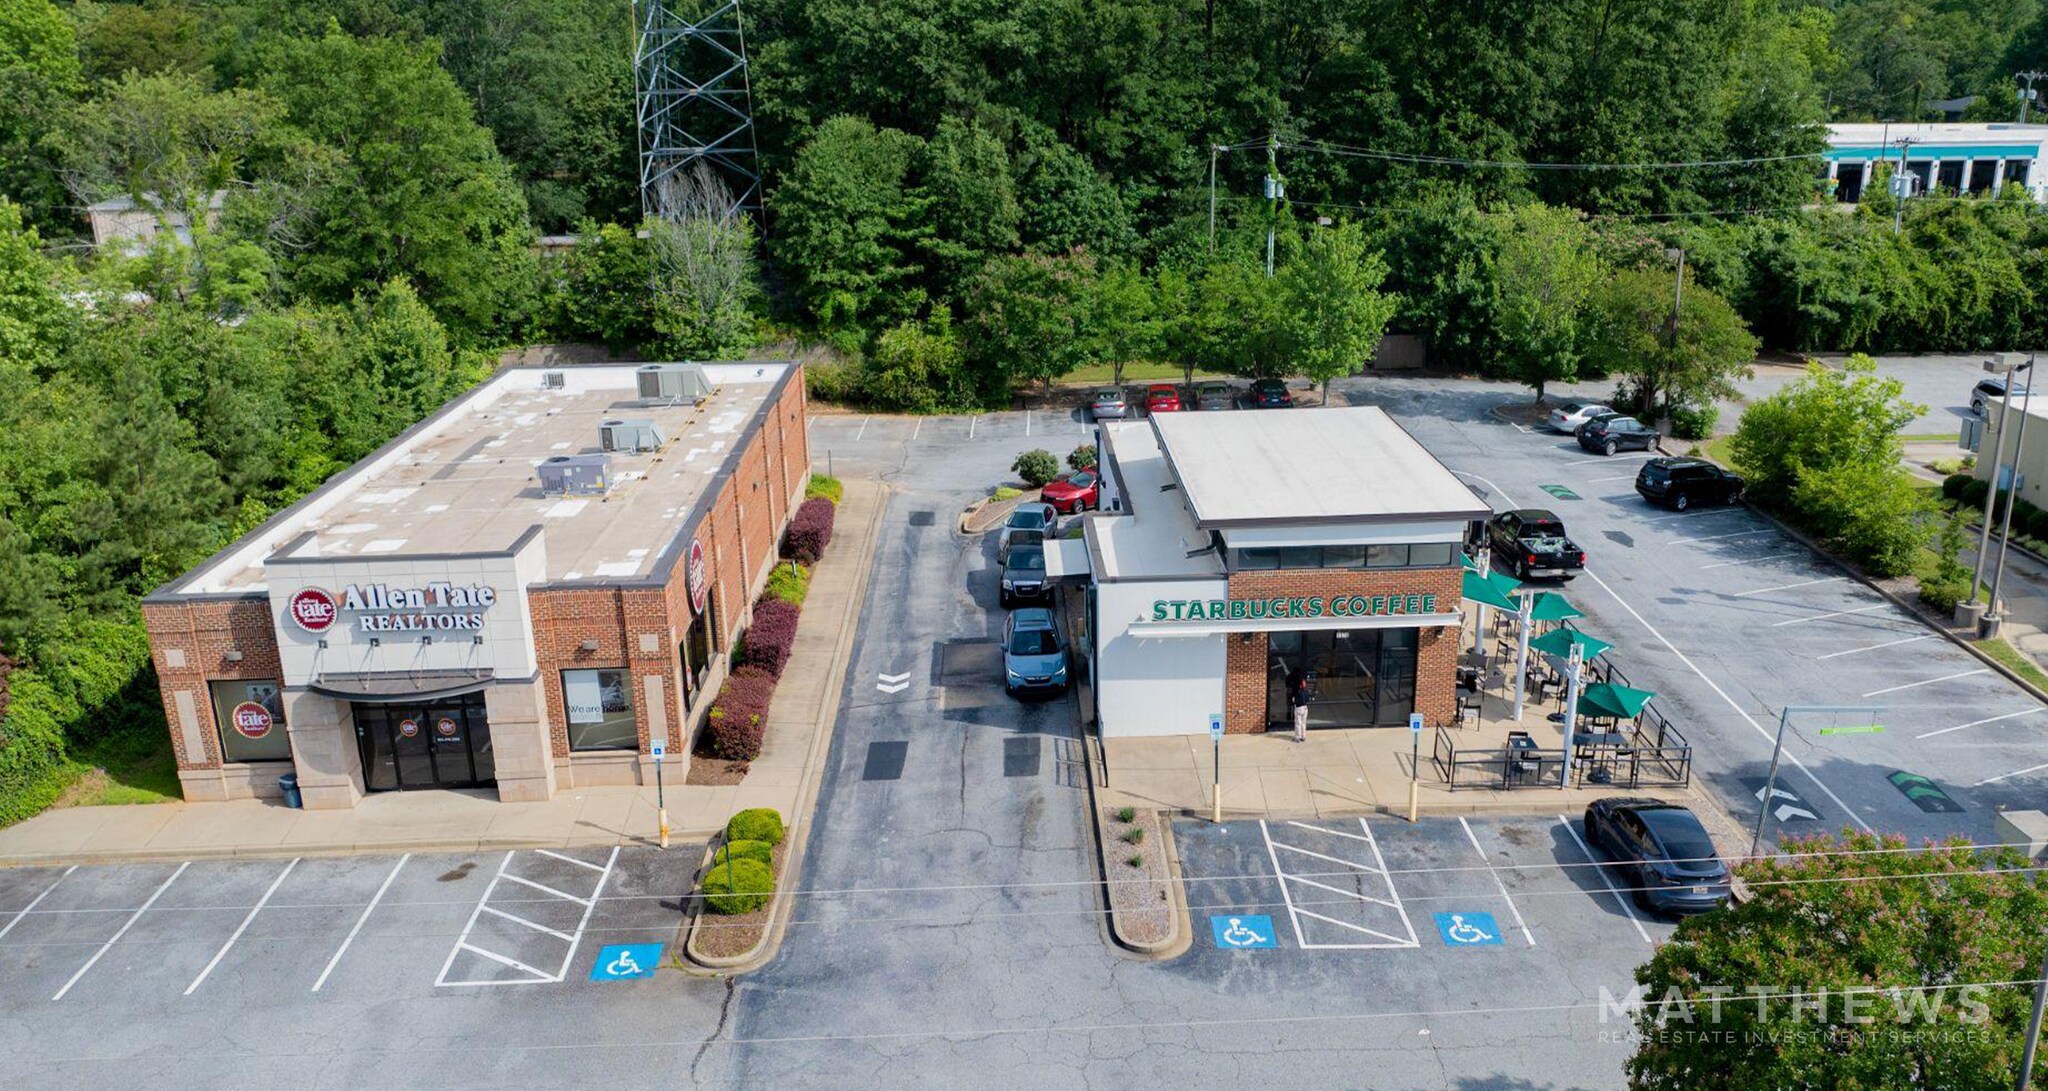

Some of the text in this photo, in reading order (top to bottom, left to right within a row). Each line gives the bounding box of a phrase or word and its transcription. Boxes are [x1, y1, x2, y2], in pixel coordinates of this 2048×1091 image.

[343, 582, 495, 610] Allen Tate
[296, 598, 332, 617] tate
[1152, 594, 1436, 620] STARBUCKS COFFEE
[359, 613, 484, 632] REALTORS
[568, 704, 585, 713] We
[586, 705, 600, 713] are
[237, 710, 270, 727] tate
